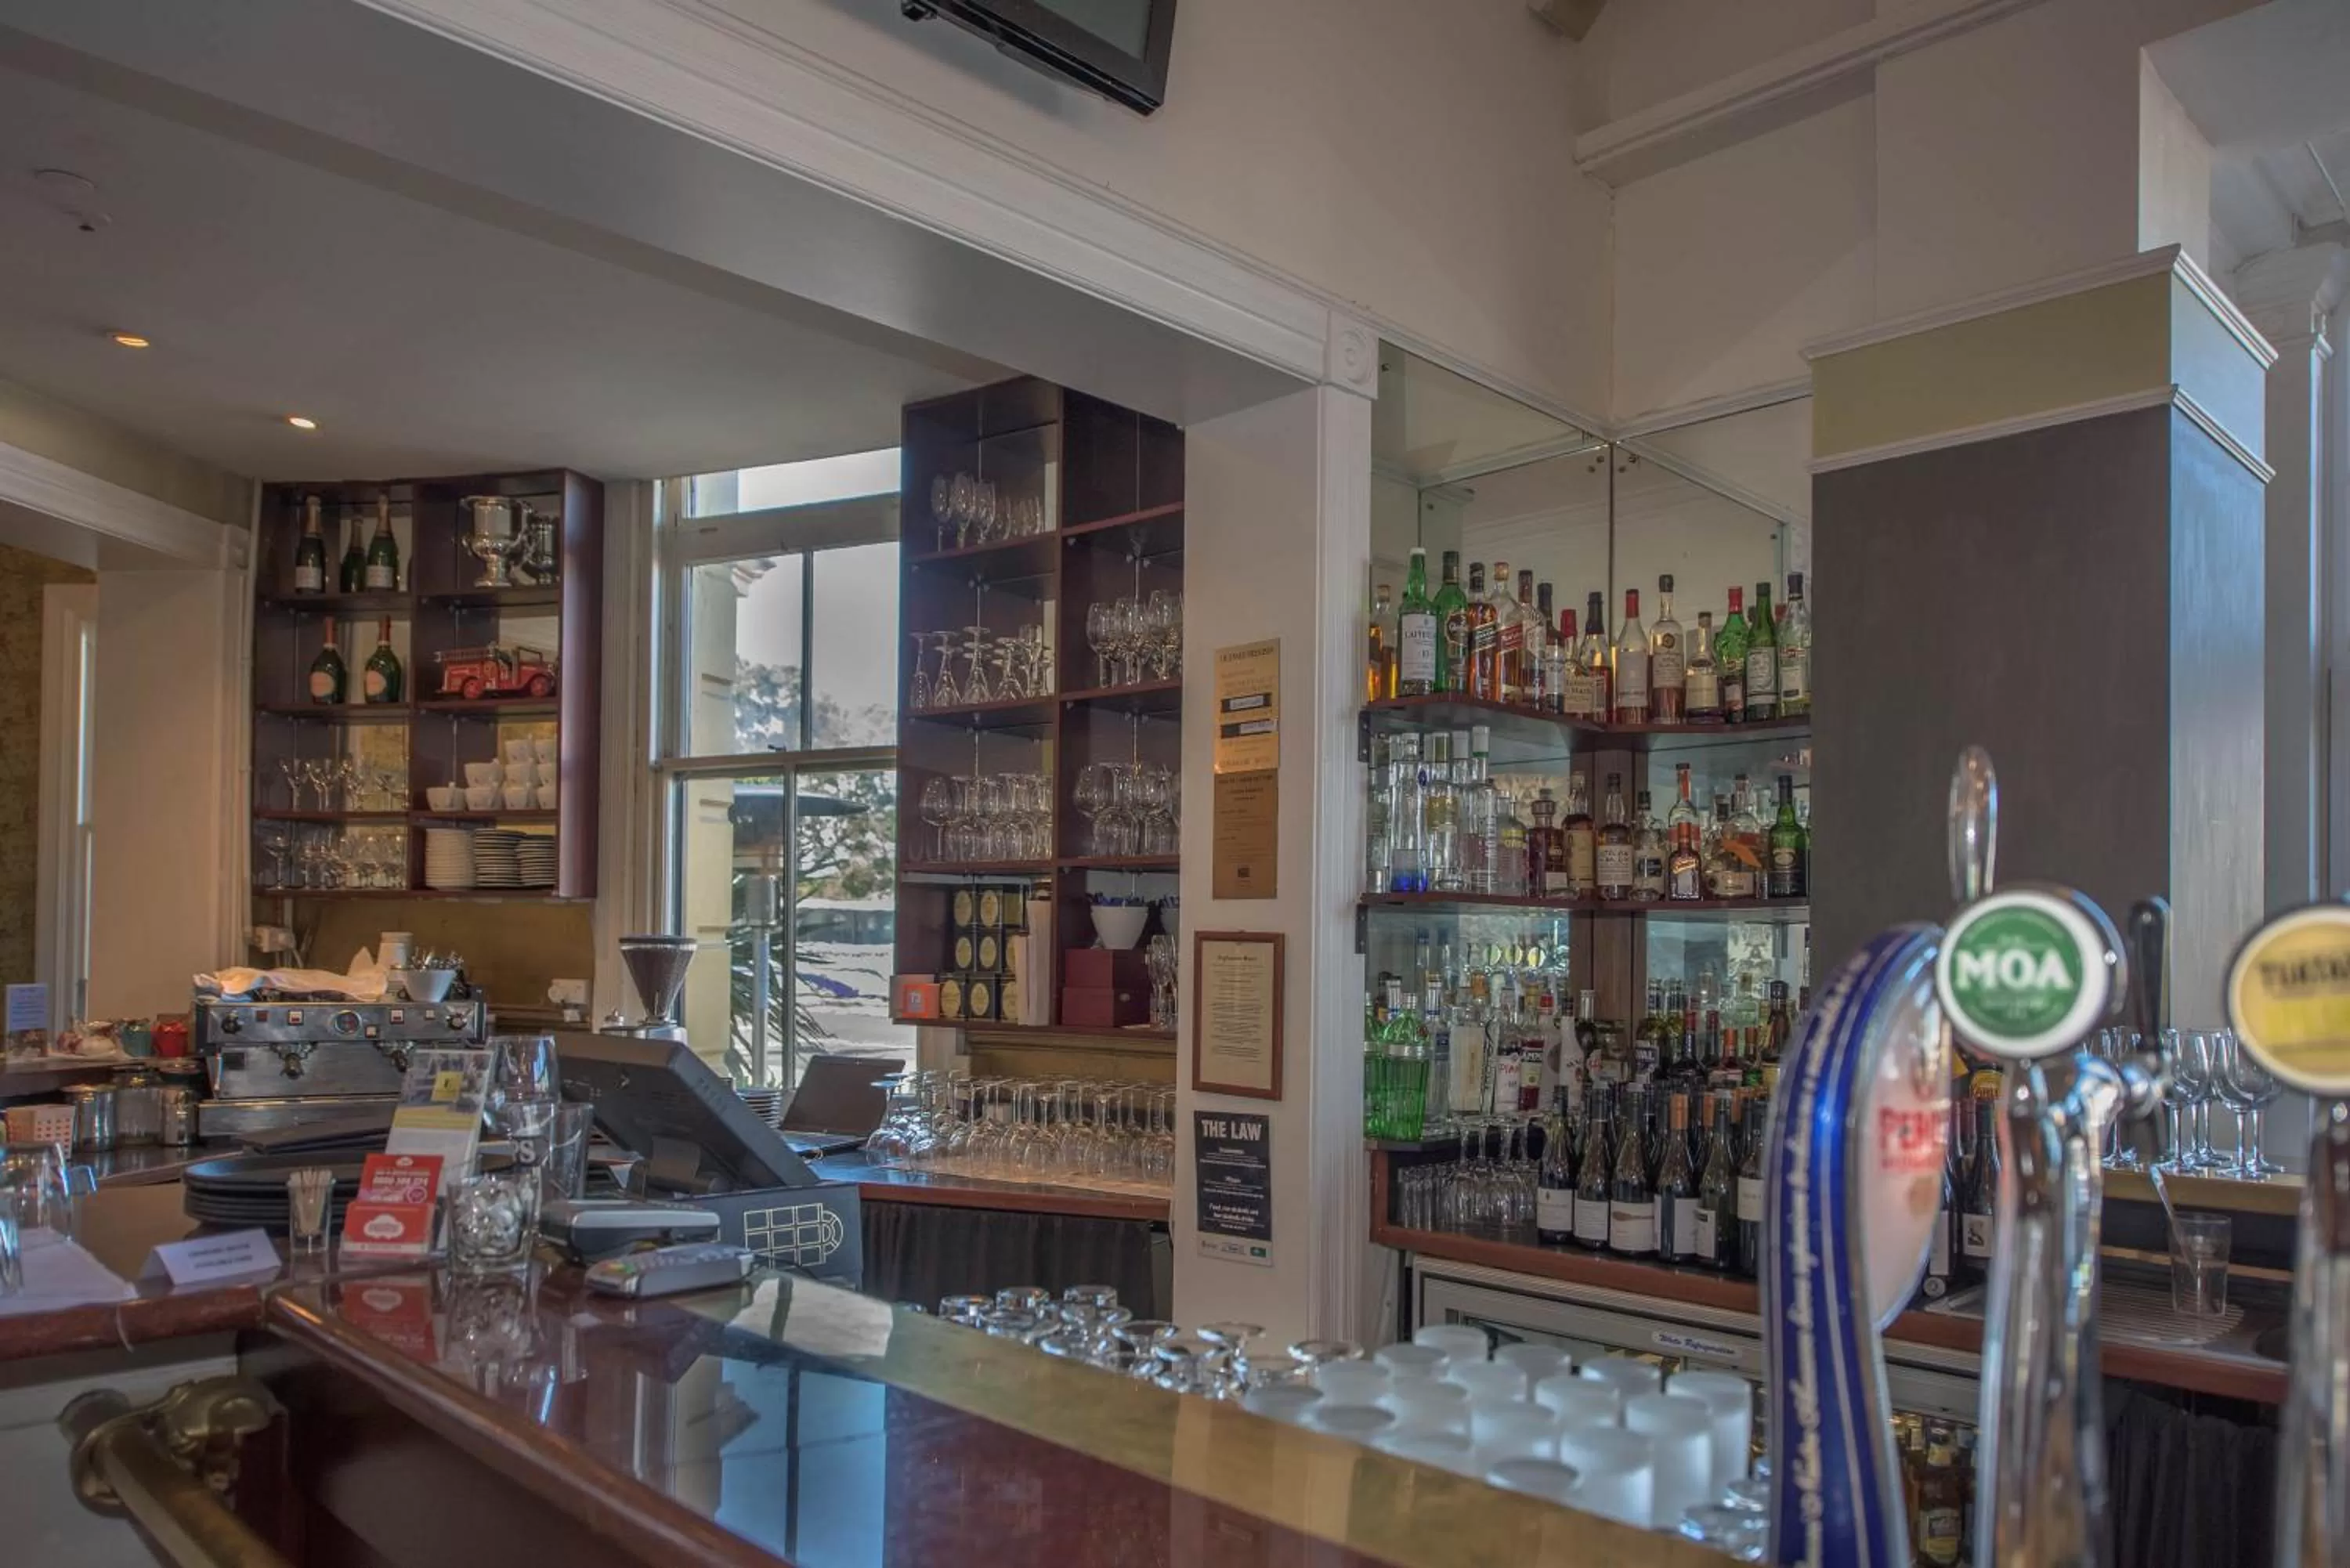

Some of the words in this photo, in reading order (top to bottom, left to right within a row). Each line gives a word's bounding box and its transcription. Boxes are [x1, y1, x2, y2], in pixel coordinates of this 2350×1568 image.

[1955, 948, 2073, 992] MOA
[1201, 1119, 1227, 1138] THE
[1231, 1121, 1262, 1140] LAW
